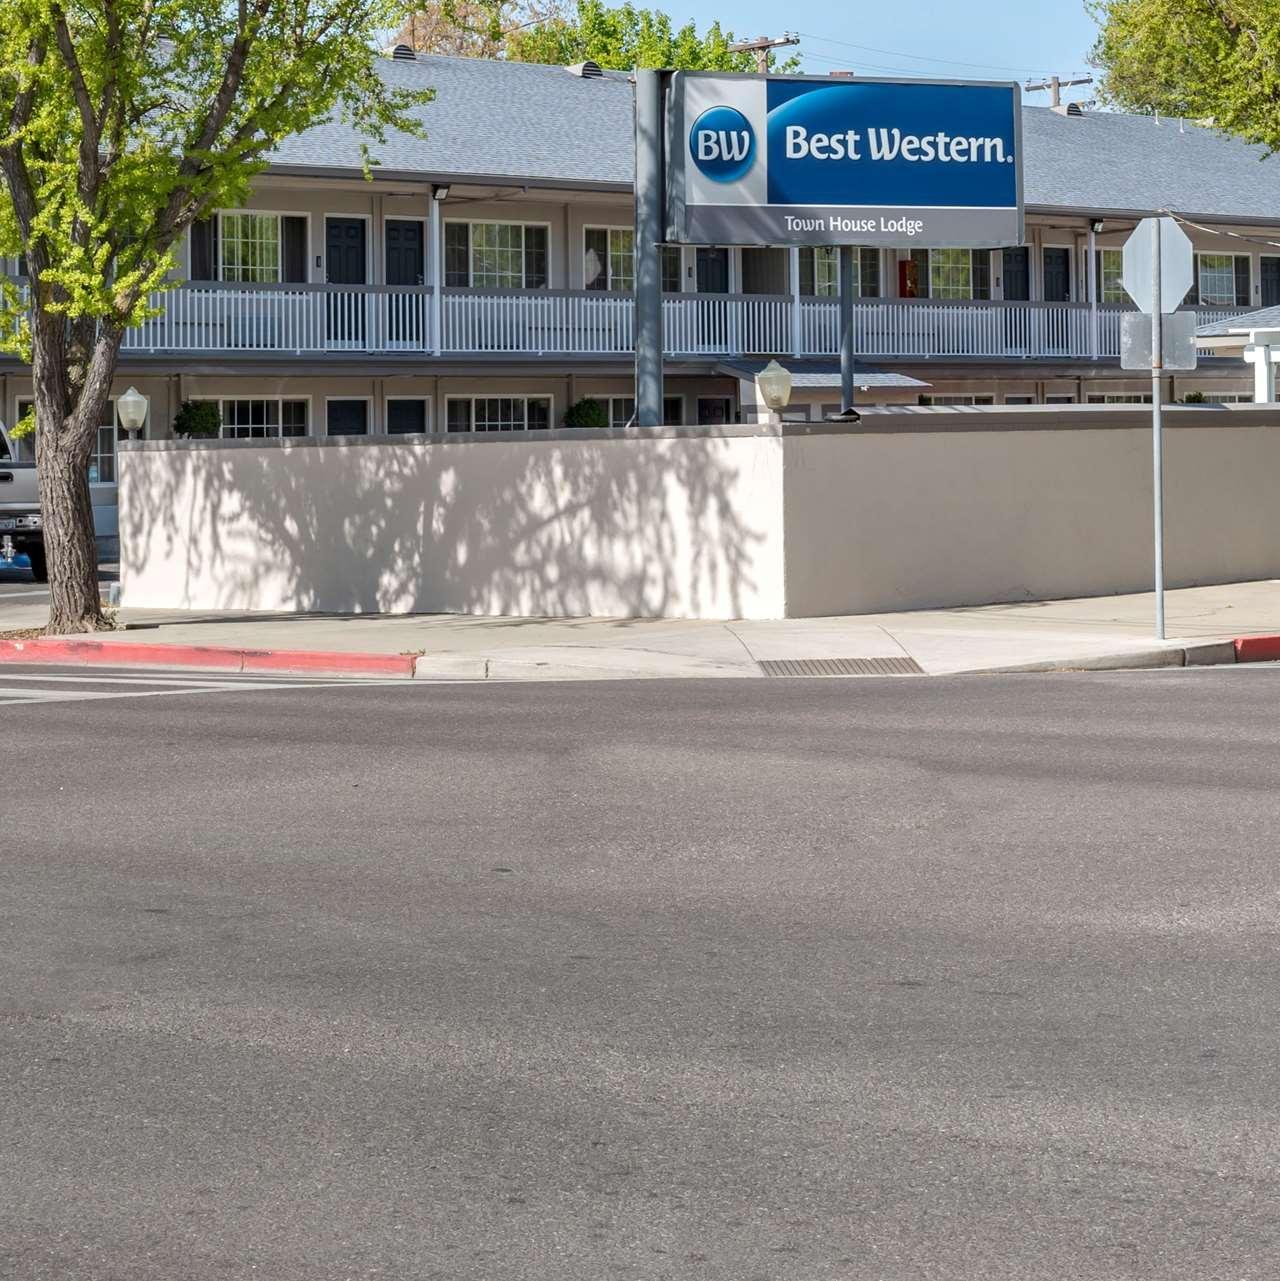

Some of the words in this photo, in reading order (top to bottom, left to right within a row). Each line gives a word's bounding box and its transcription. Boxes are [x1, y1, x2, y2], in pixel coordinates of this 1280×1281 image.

[697, 129, 750, 162] BW
[785, 125, 861, 161] Best
[784, 215, 825, 232] Town
[829, 216, 876, 232] House
[880, 216, 924, 236] Lodge
